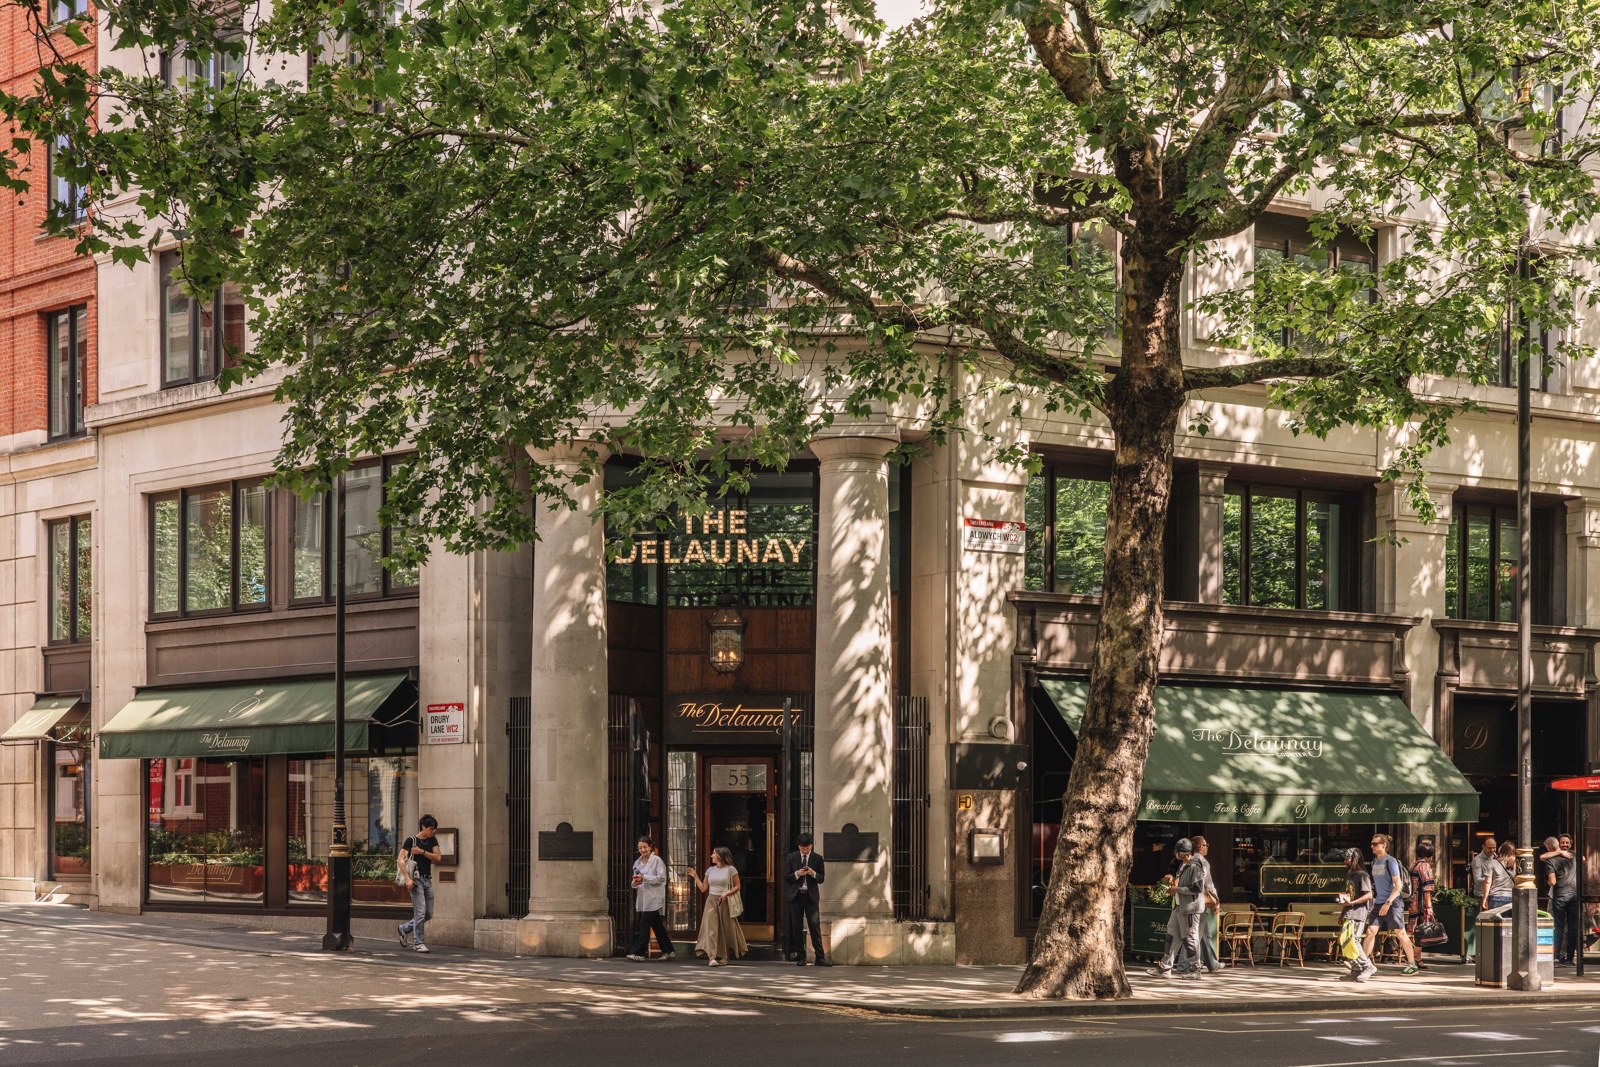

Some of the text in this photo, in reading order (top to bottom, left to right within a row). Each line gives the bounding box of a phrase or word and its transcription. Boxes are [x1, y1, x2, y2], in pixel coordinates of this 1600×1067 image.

[679, 509, 748, 535] THE
[970, 530, 1018, 542] ALDWYCH WC2
[614, 538, 807, 564] DELAUNAY
[673, 702, 706, 719] The
[430, 715, 449, 724] DRURY
[430, 724, 459, 734] LANE WC2
[200, 732, 251, 753] The Delaunay
[1191, 728, 1324, 758] The Delaunay
[728, 769, 750, 787] 55
[1146, 799, 1183, 814] Breakfast
[1213, 802, 1230, 814] Tea
[1240, 803, 1262, 817] Coffee
[1333, 804, 1351, 817] Cafe
[1359, 804, 1376, 815] Bar
[1398, 803, 1426, 815] Pastries
[1434, 803, 1455, 814] Cakes
[1289, 872, 1328, 888] All Day
